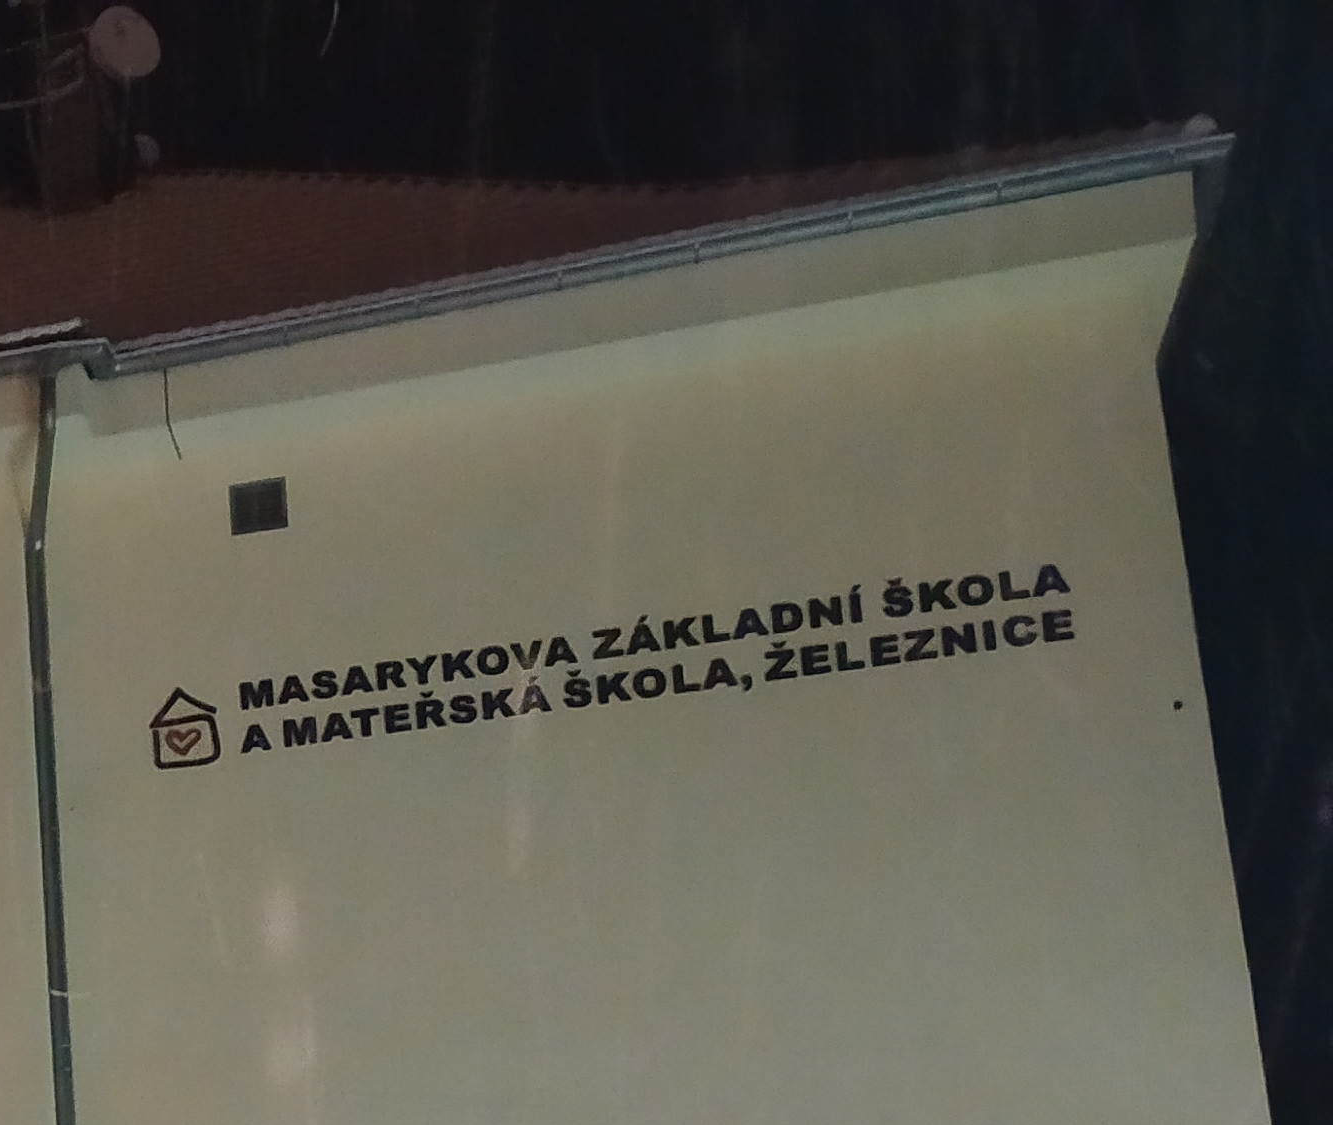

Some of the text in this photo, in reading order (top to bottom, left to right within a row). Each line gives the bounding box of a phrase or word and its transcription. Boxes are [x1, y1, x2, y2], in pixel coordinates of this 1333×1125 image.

[238, 563, 1072, 711] MASARYKOVA ZÁKLADNÍ ŠKOLA
[240, 608, 1076, 754] A MATEŘSKÁ ŠKOLA, ŽELEZNICE
